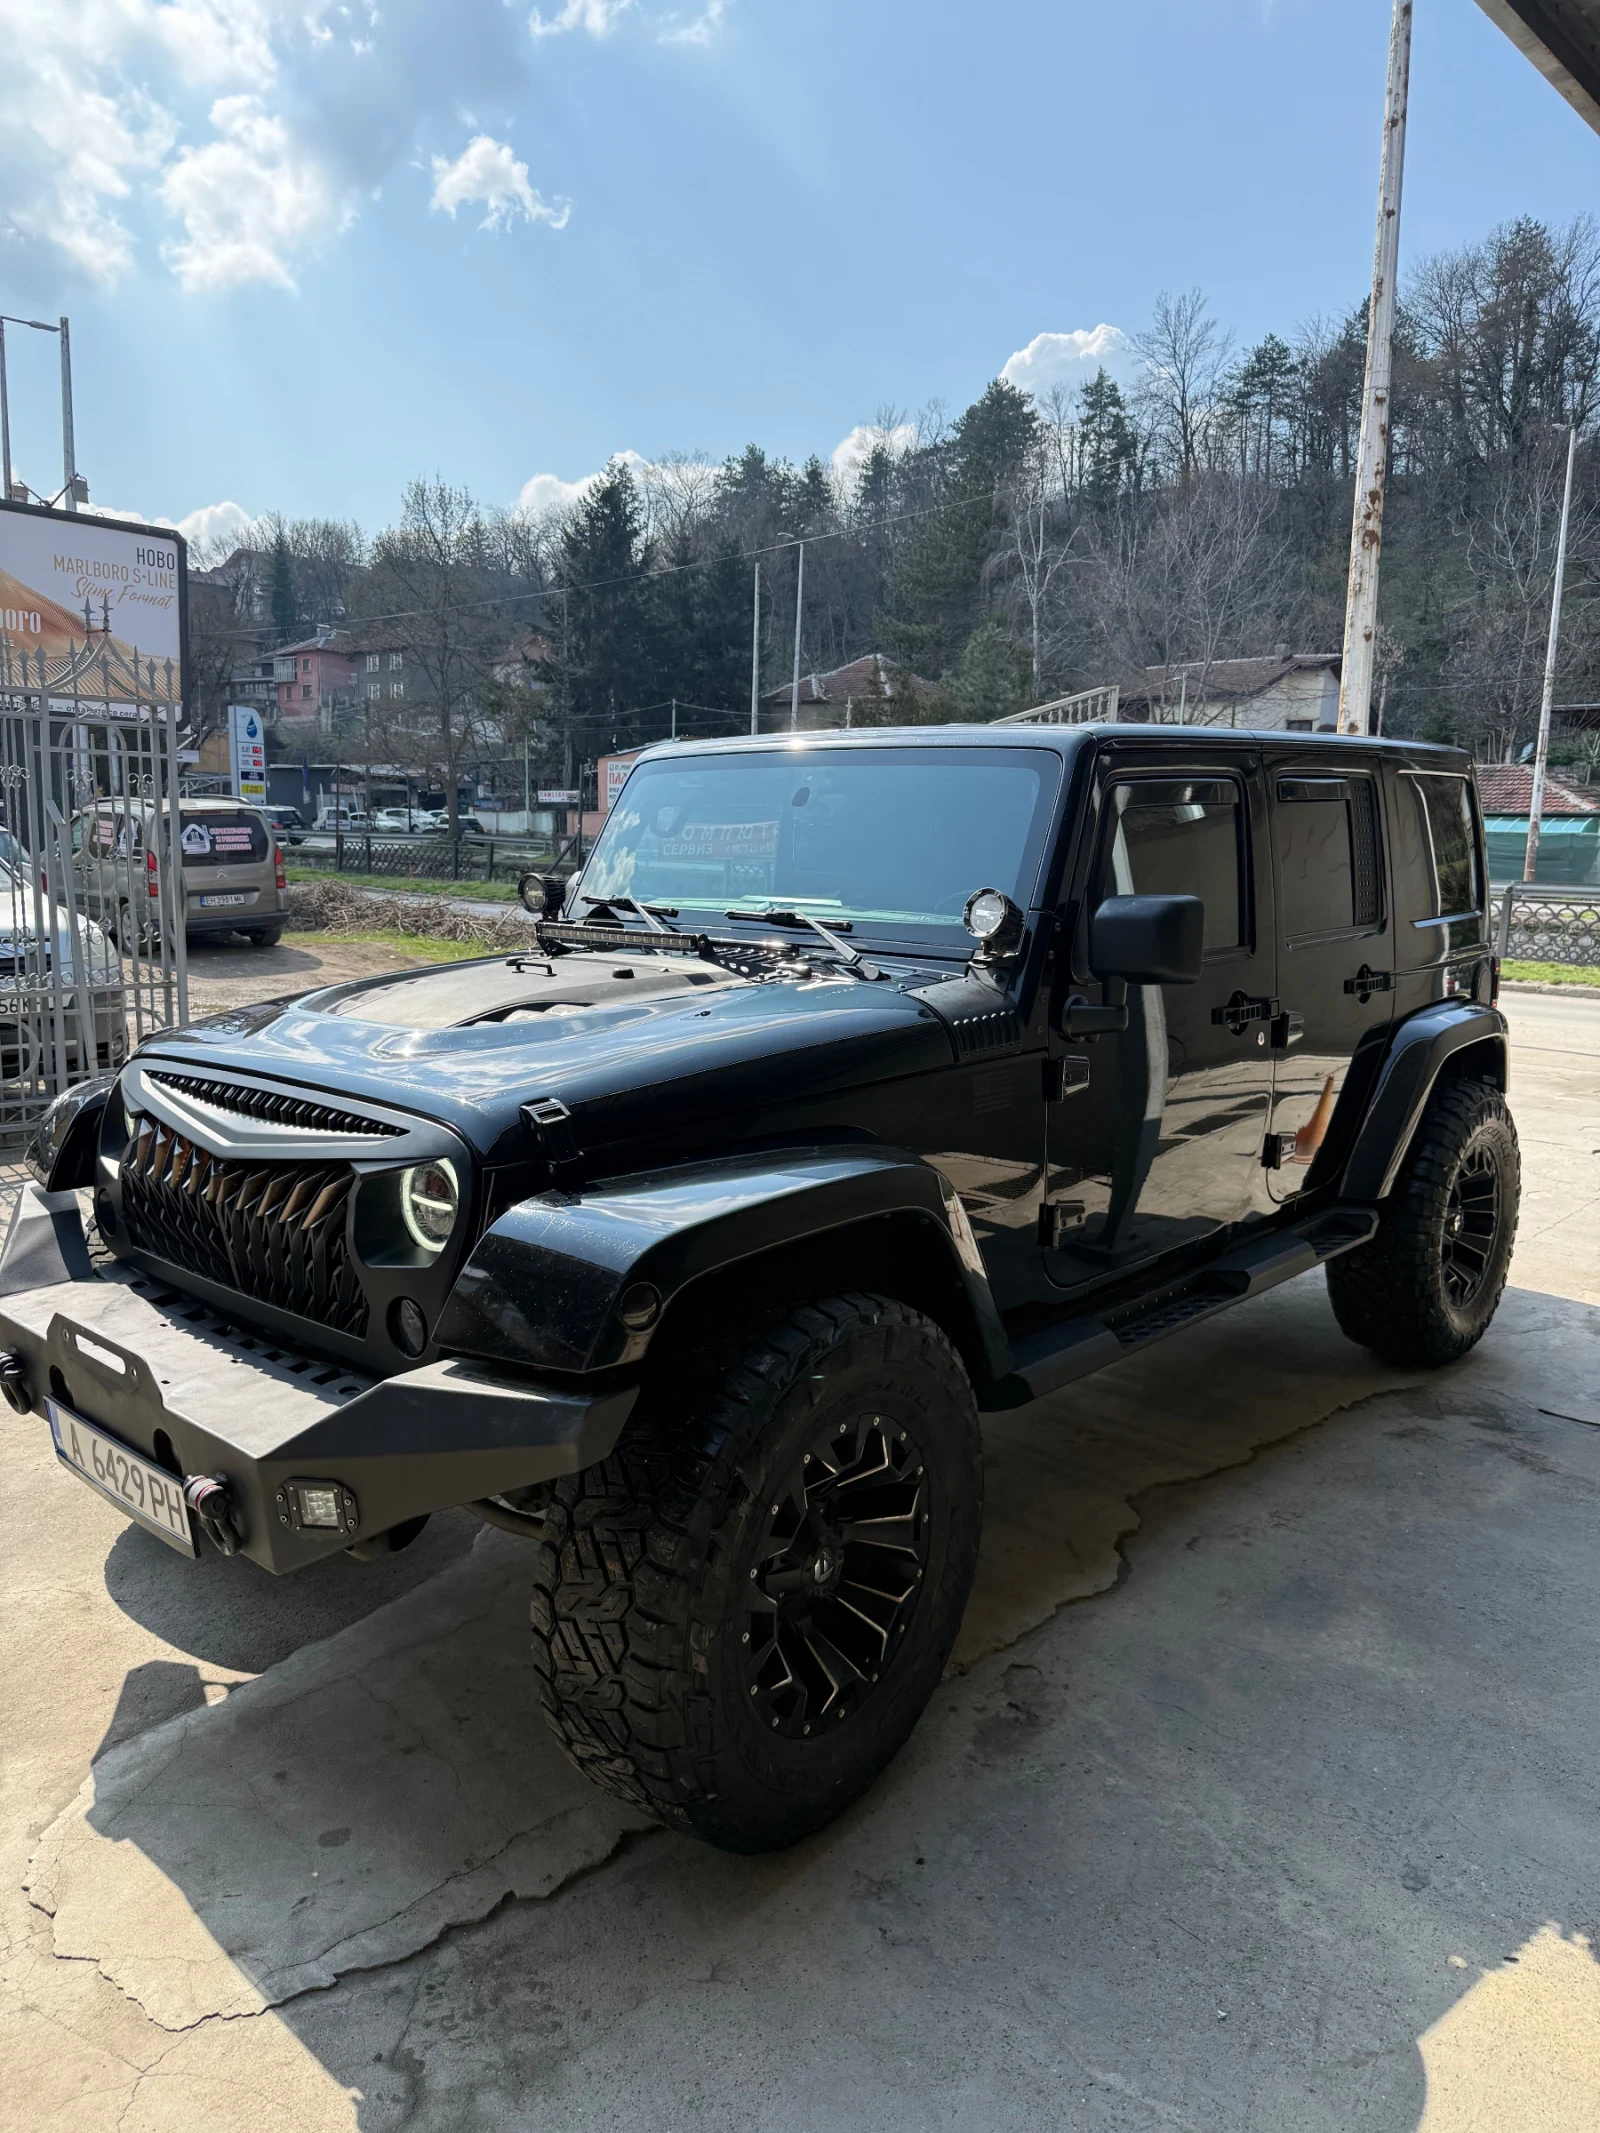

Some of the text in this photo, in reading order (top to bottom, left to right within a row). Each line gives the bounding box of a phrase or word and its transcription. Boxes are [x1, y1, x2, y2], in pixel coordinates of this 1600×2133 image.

[53, 554, 129, 582] MARLBORO
[136, 547, 175, 570] НОВО
[117, 584, 175, 610] Format
[663, 842, 714, 856] СЕРВИЗ
[92, 1438, 145, 1508] 6429
[147, 1473, 187, 1536] PH
